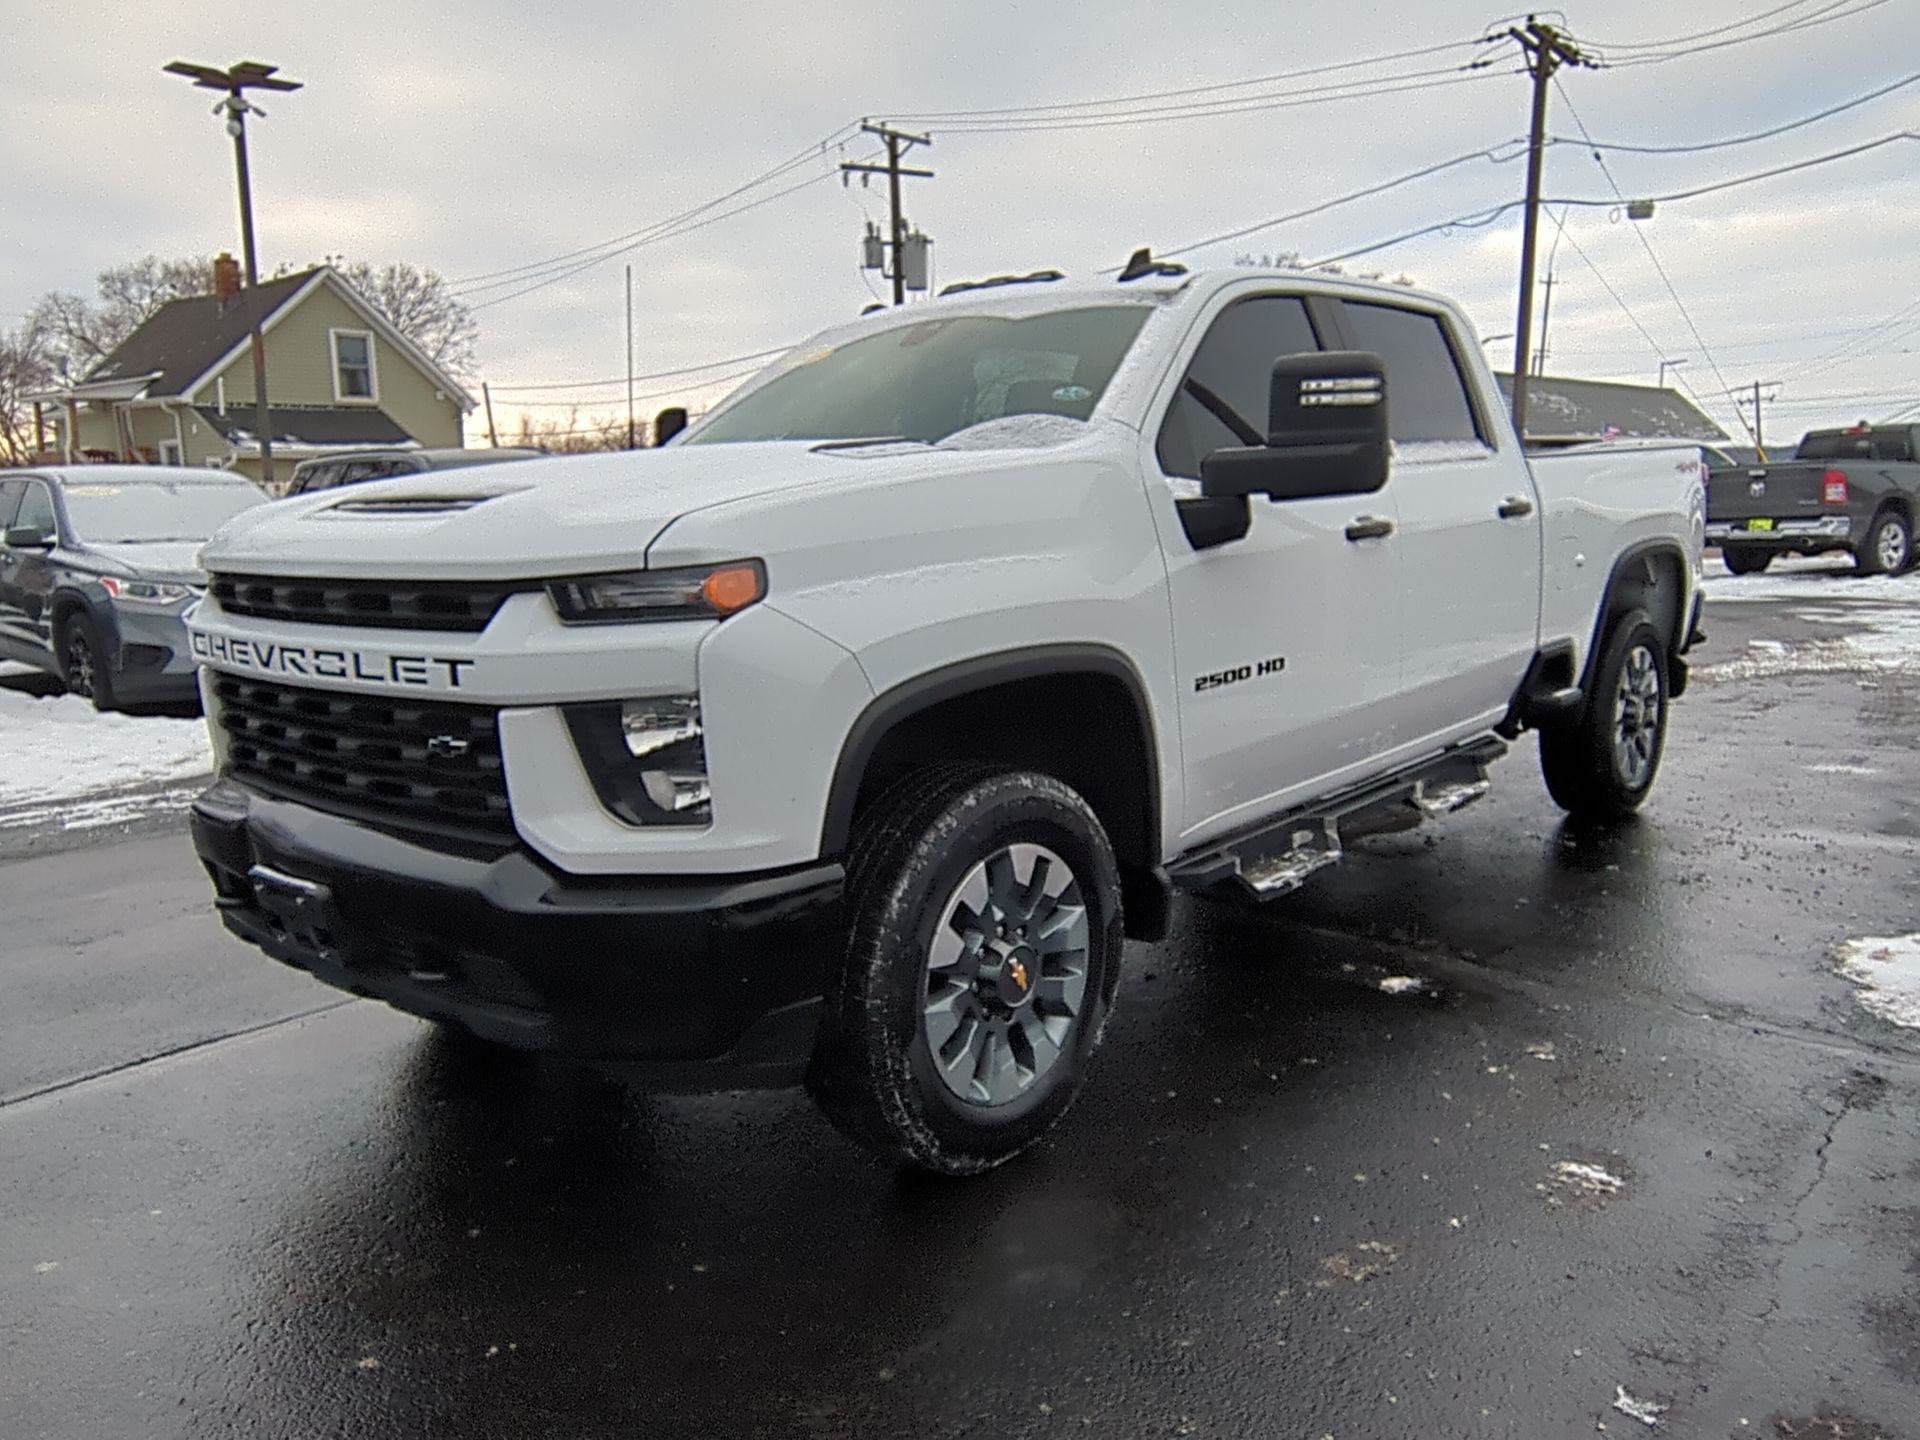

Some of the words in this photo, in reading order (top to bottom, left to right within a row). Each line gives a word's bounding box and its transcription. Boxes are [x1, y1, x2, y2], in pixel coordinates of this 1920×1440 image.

[192, 632, 474, 687] CHEVROLET
[1195, 665, 1251, 692] 2500
[1257, 657, 1285, 676] HD
